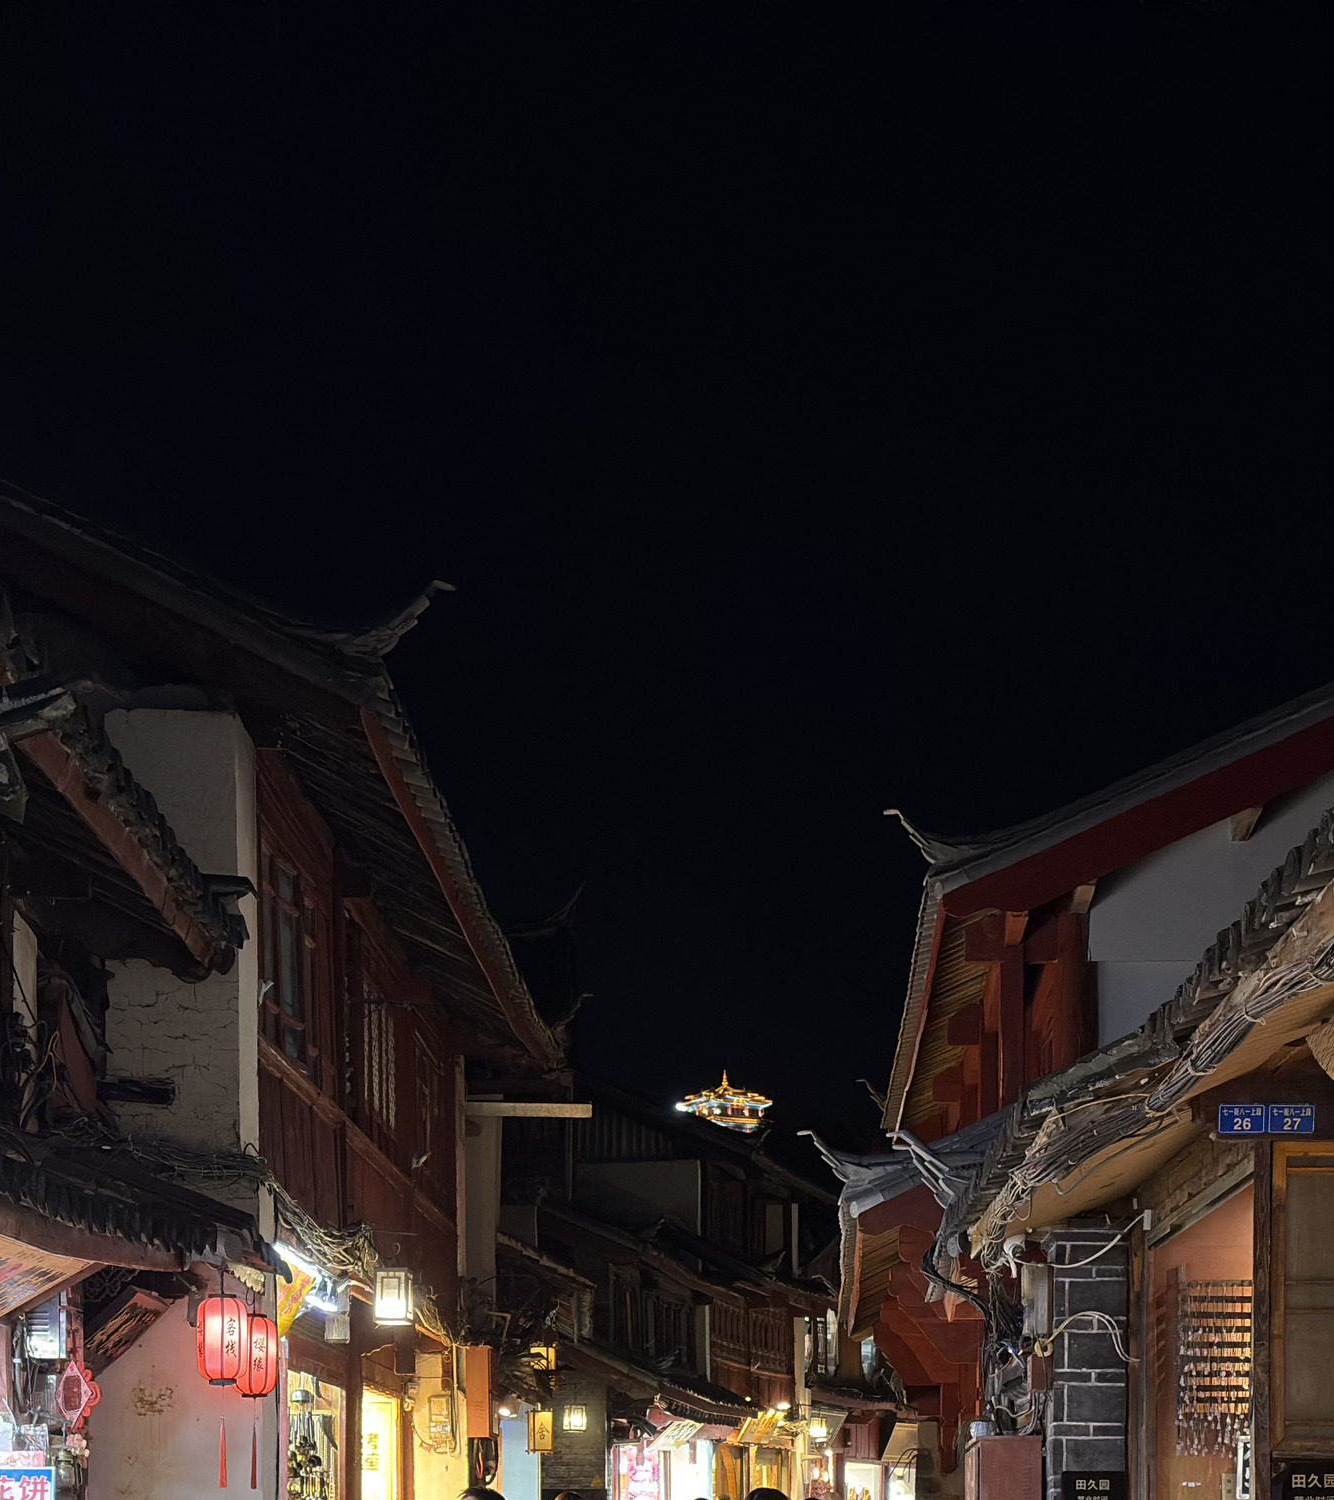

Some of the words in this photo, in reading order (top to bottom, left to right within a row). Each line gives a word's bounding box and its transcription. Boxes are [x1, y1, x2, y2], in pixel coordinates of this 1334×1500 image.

[1233, 1118, 1251, 1130] 26
[1283, 1118, 1301, 1130] 27
[225, 1317, 237, 1358] 客栈
[536, 1423, 550, 1440] 舍
[1075, 1479, 1110, 1491] 田久园
